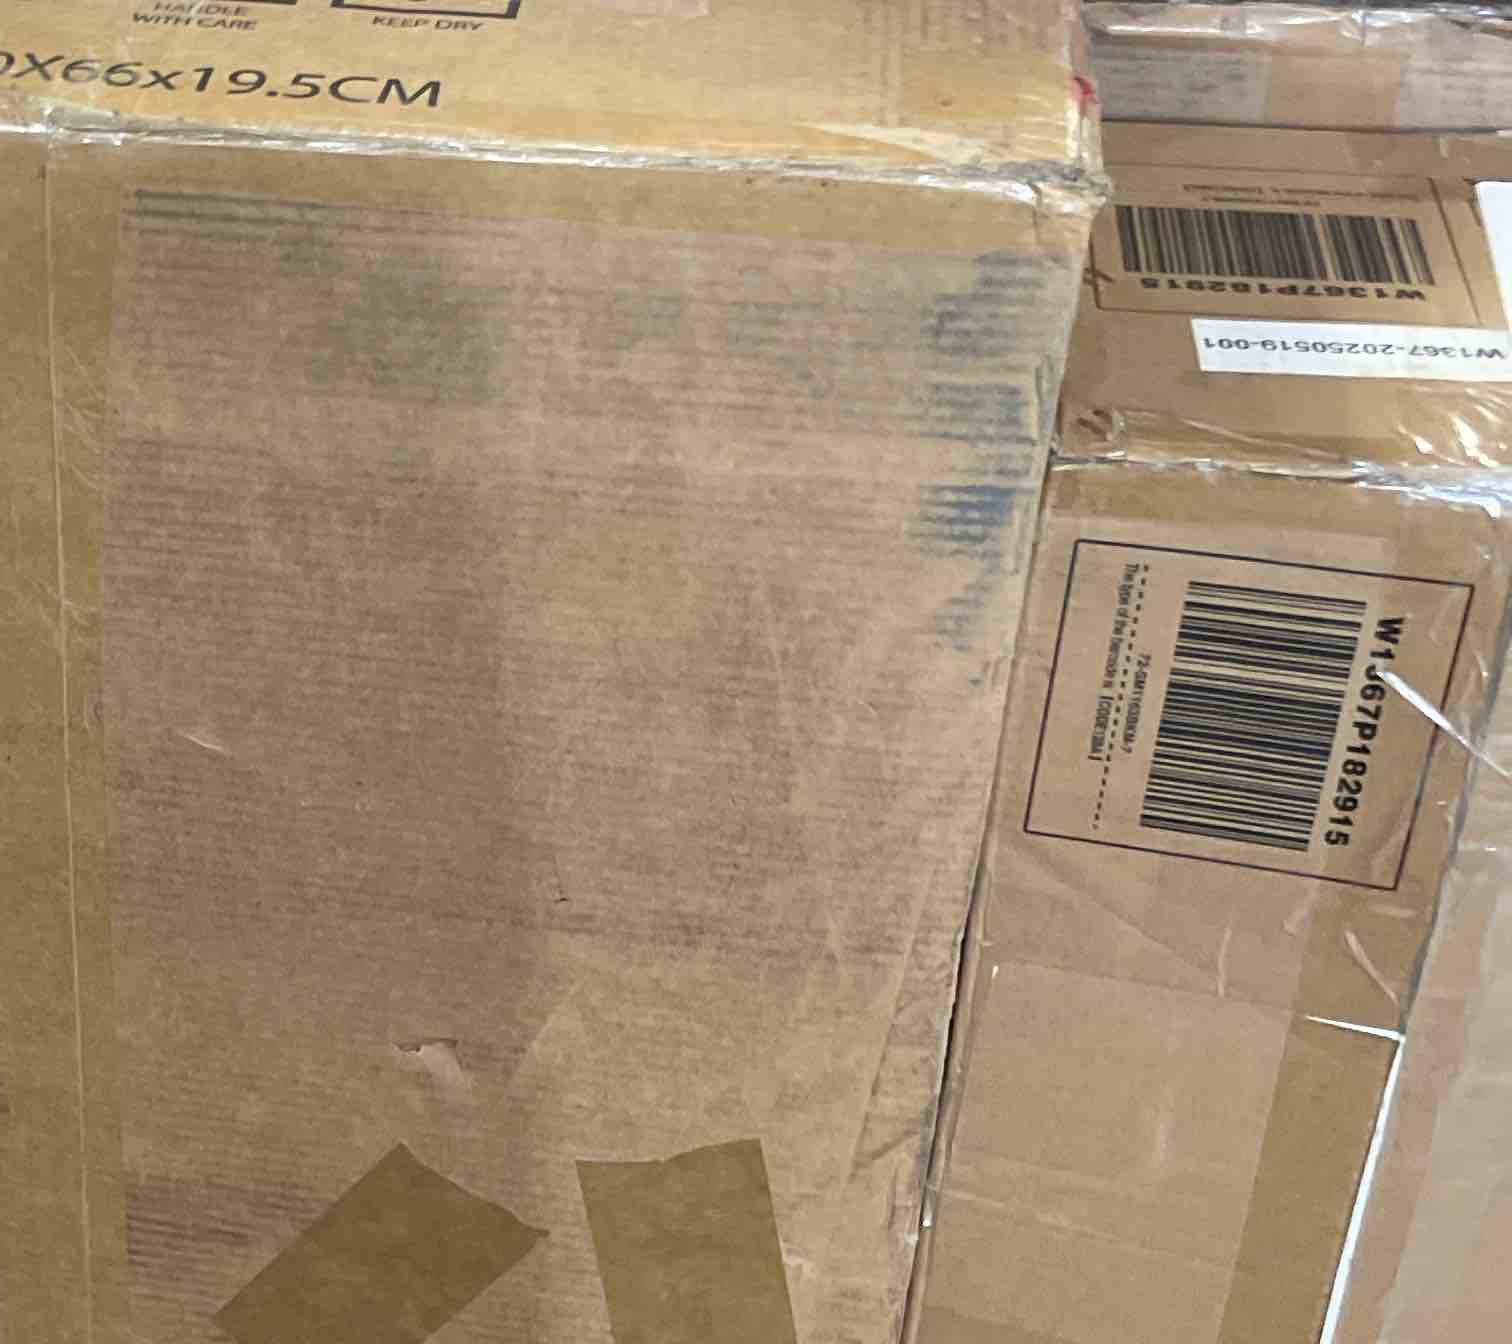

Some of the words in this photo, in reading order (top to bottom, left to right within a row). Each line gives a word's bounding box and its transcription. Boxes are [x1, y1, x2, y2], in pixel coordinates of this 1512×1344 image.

[132, 12, 191, 28] WITH
[196, 16, 257, 32] CARE
[372, 14, 427, 30] KEEP
[433, 17, 485, 34] DRY
[1202, 334, 1507, 362] W1367-20250519-001
